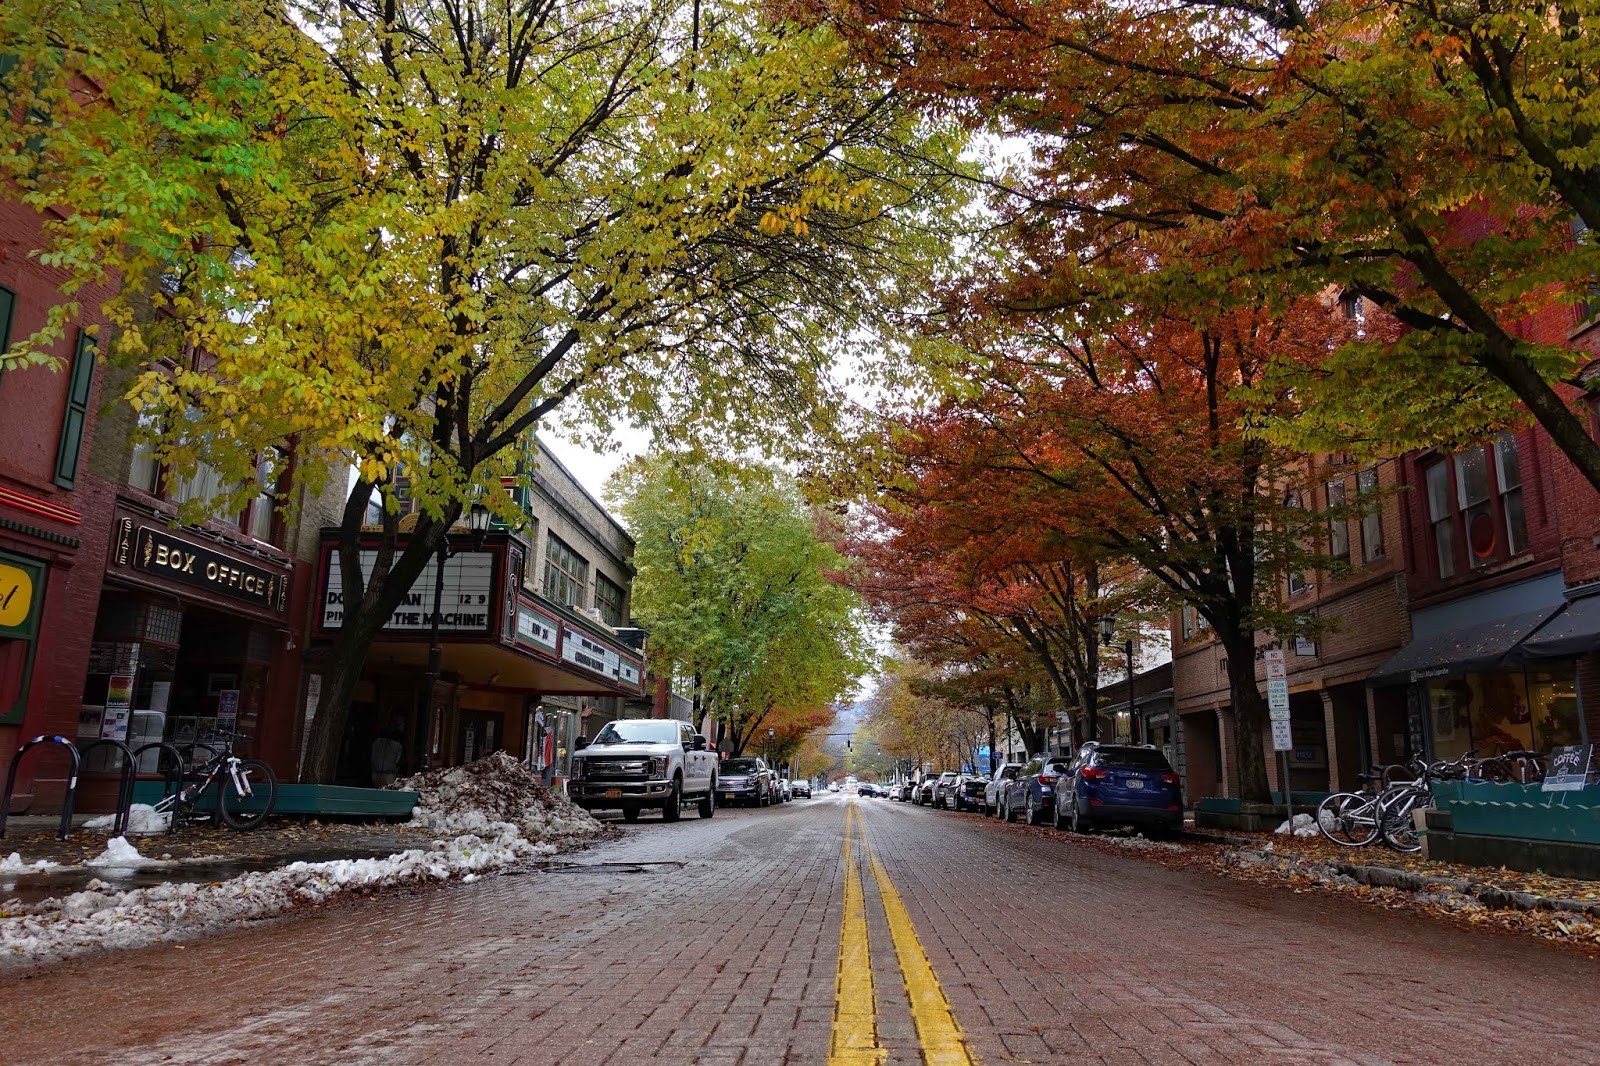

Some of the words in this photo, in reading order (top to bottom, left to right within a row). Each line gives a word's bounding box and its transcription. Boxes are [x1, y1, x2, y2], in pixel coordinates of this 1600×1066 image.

[119, 520, 132, 565] STATE
[155, 544, 196, 574] BOX
[206, 561, 265, 596] OFFICE
[279, 577, 289, 612] STATE
[460, 594, 471, 604] 12
[478, 594, 486, 604] 9
[394, 613, 420, 624] THE
[423, 613, 486, 626] MACHINE
[1553, 752, 1580, 767] COFFEE
